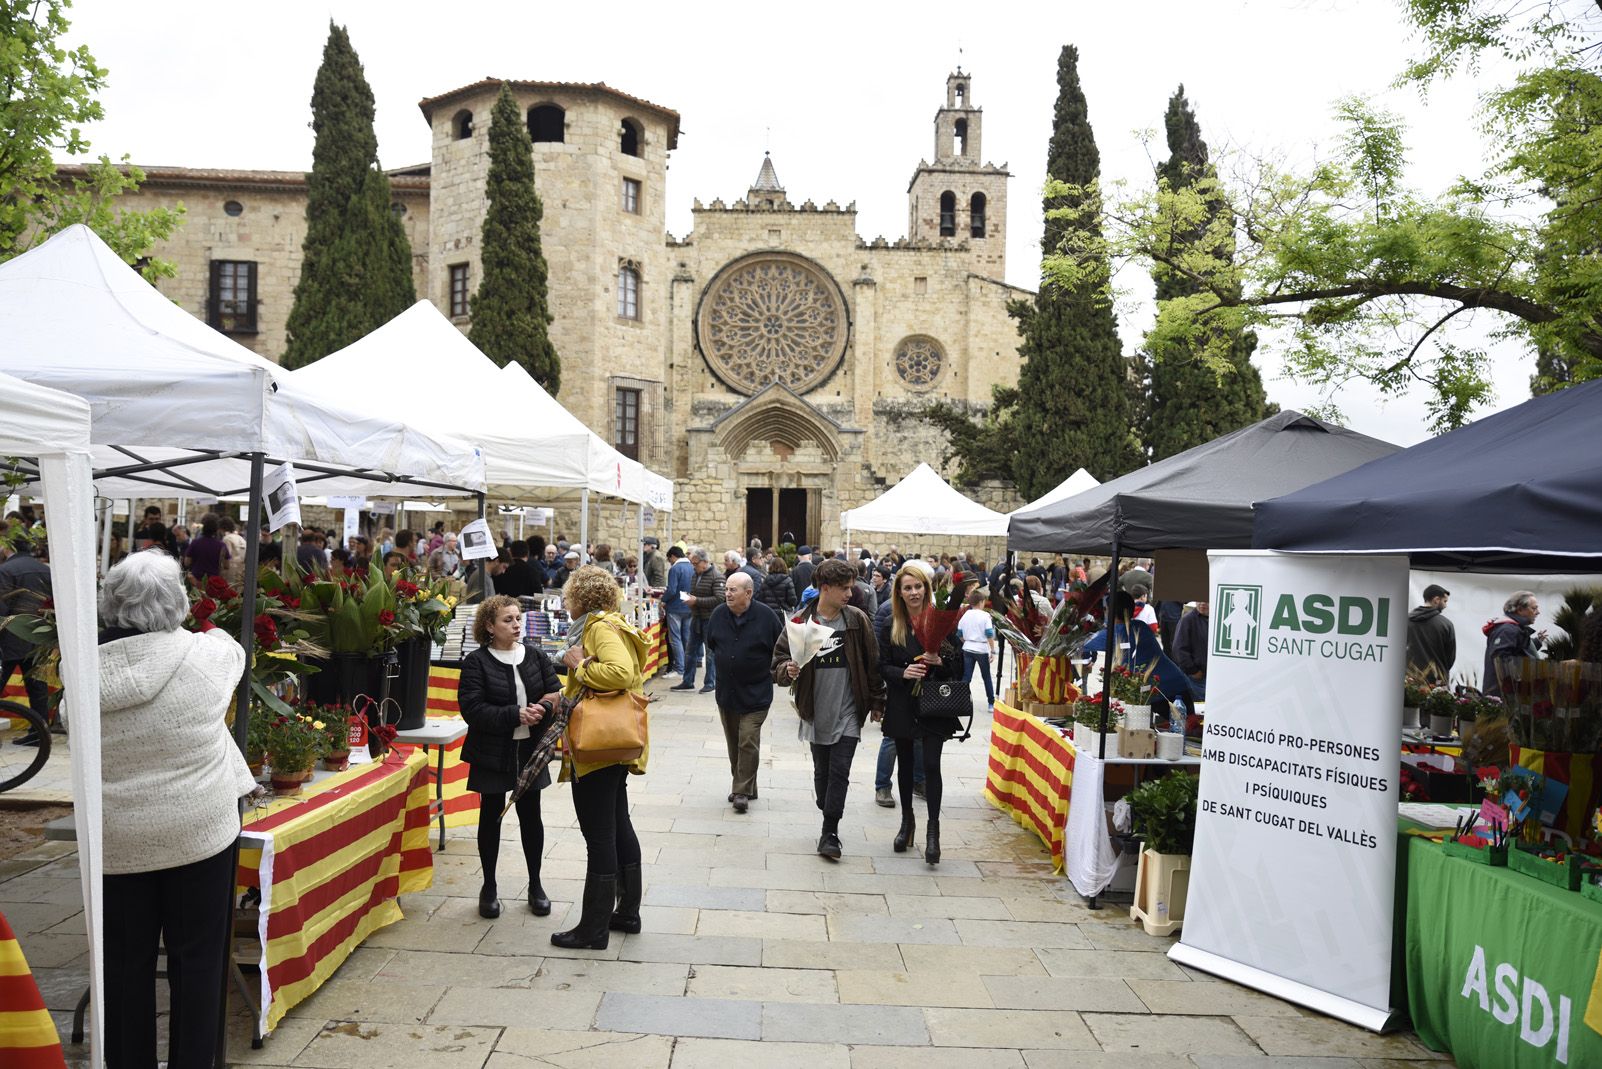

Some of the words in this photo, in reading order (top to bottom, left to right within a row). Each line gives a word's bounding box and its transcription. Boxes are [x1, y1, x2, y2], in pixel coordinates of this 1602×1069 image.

[1269, 594, 1390, 637] ASDI
[1267, 636, 1316, 657] SANT
[1320, 640, 1388, 662] CUGAT
[1206, 723, 1275, 744] ASSOCIACIÓ
[1278, 733, 1380, 762] PRO-PERSONES
[1202, 749, 1225, 763] AMB
[1229, 753, 1322, 780] DISCAPACITATS
[1325, 766, 1388, 792] FÍSIQUES
[1245, 782, 1249, 793] I
[1252, 782, 1327, 809] PSÍQUIQUES
[1202, 800, 1217, 814] DE
[1220, 804, 1252, 820] SANT
[1255, 811, 1295, 830] CUGAT
[1298, 820, 1323, 837] DEL
[1326, 825, 1377, 849] VALLÈS
[1460, 944, 1571, 1065] ASDI
